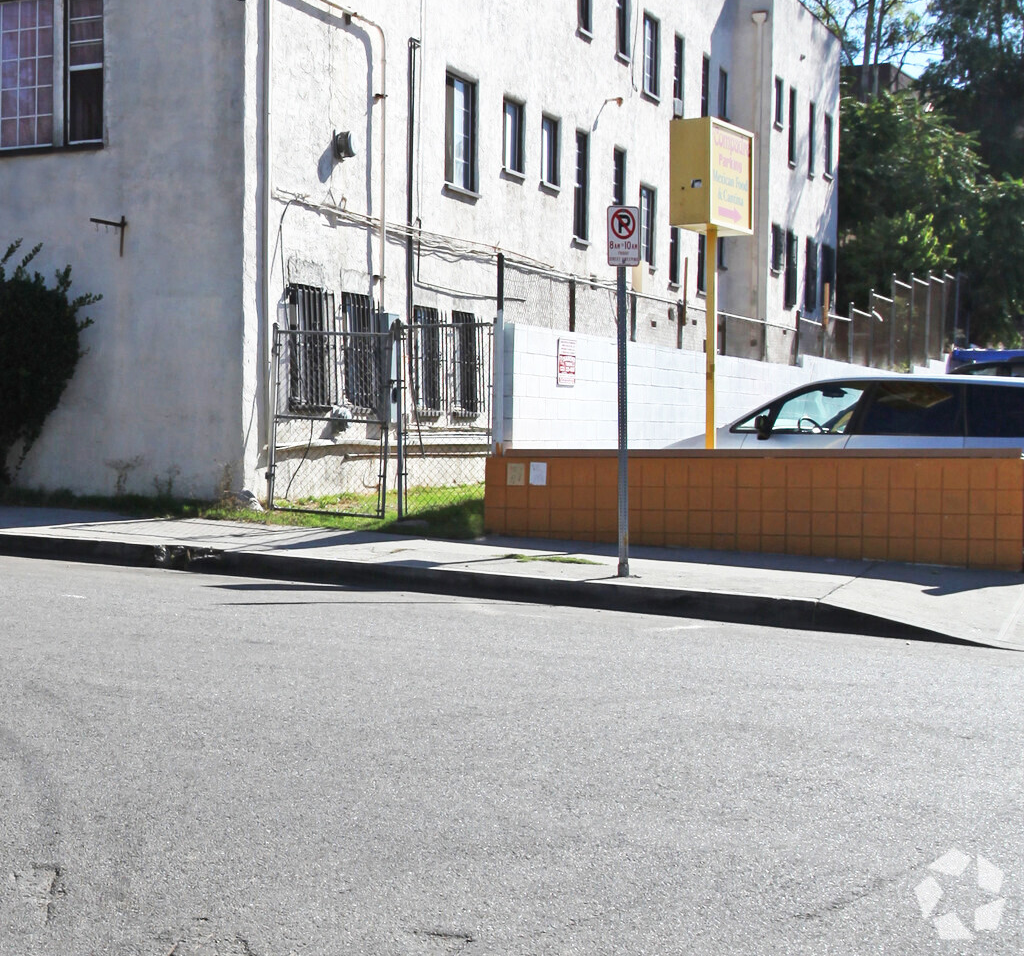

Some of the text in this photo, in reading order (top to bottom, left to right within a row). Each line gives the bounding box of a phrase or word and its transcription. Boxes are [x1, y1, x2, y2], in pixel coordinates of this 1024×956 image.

[719, 153, 743, 173] Parking
[712, 168, 748, 192] Mexican Food
